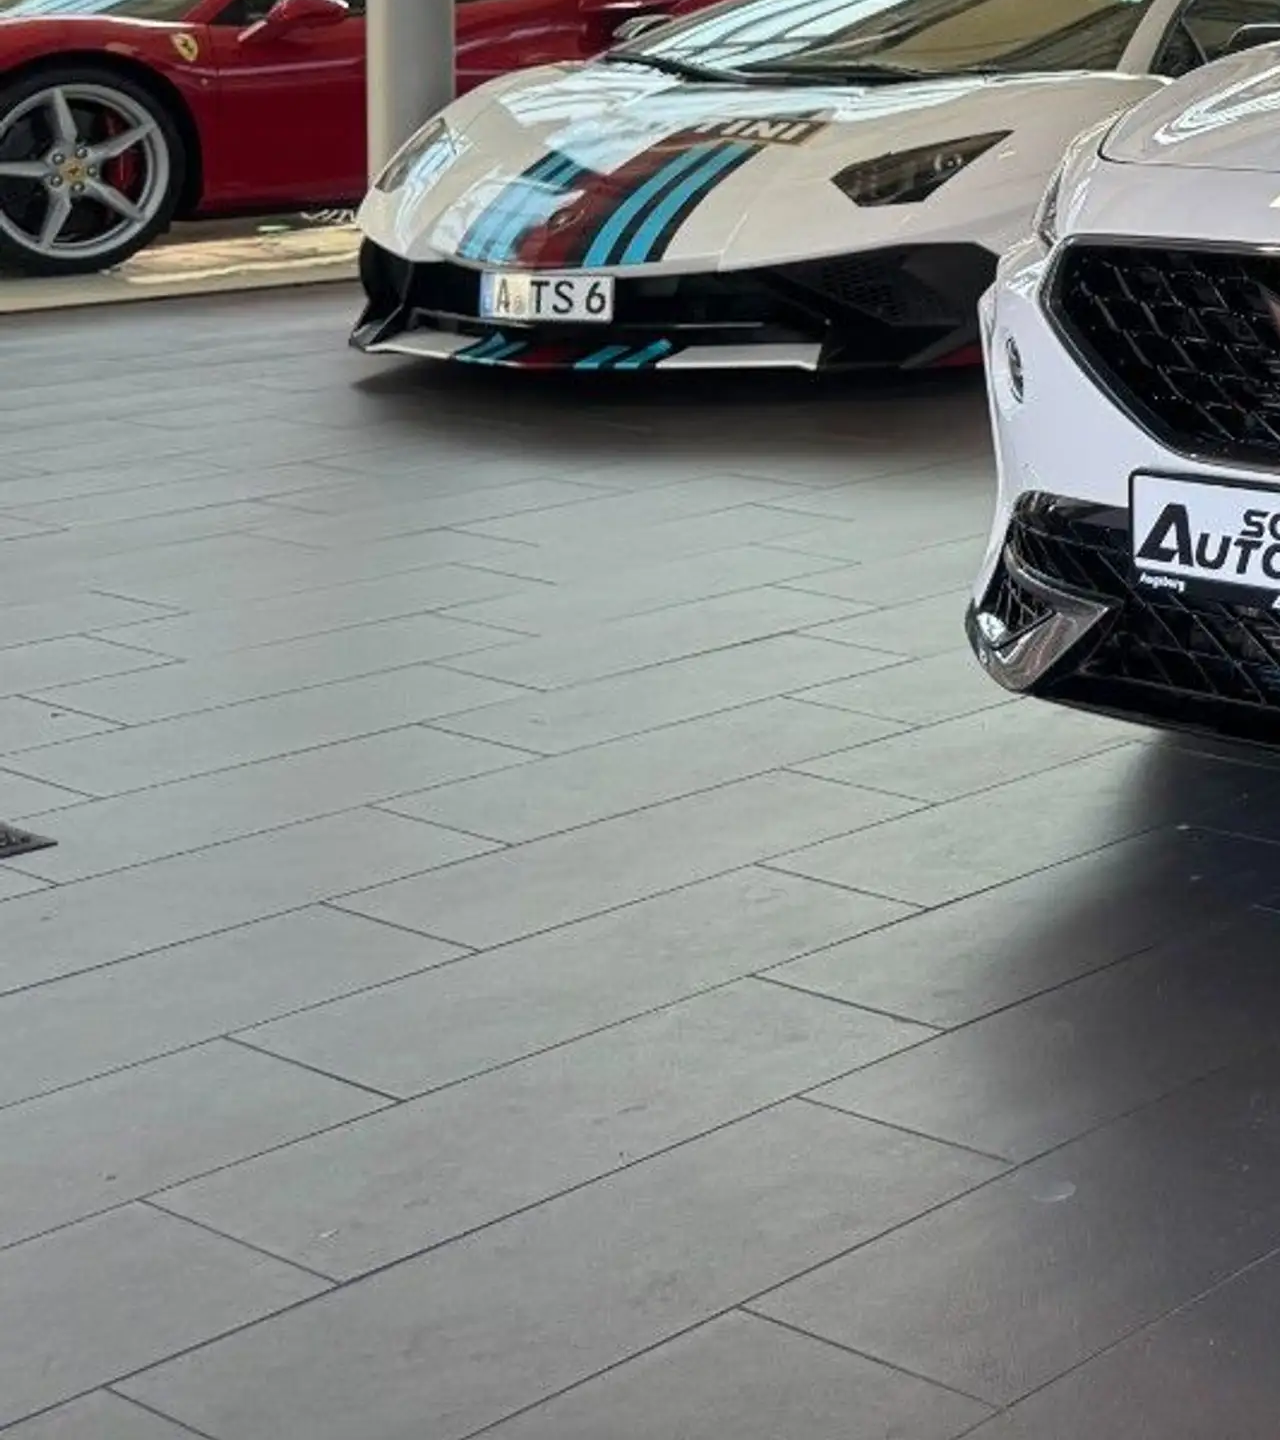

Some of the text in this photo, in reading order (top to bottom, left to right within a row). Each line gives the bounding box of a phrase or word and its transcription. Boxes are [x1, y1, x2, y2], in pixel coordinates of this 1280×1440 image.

[495, 277, 606, 314] A TS 6
